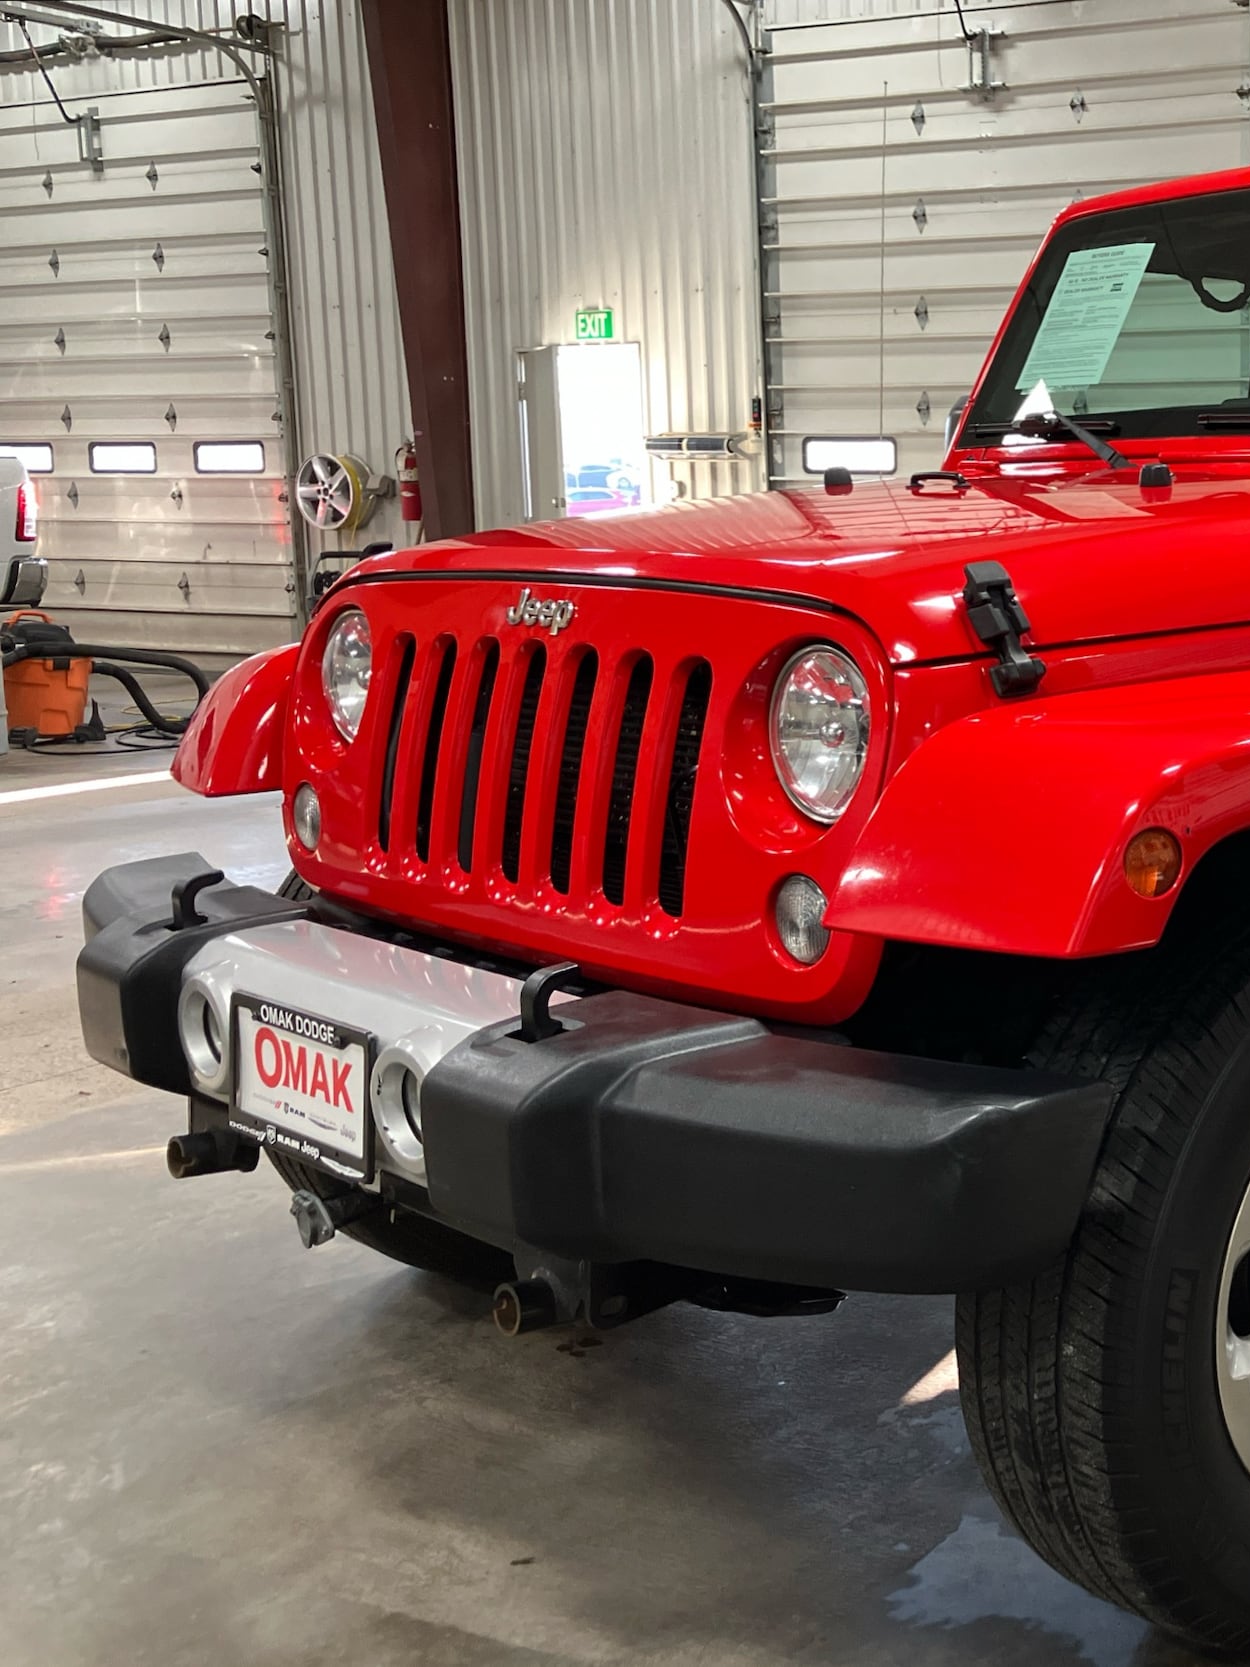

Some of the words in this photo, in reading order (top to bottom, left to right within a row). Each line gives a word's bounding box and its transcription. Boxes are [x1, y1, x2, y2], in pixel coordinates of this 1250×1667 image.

[577, 313, 608, 338] EXIT
[506, 588, 574, 636] Jeep
[260, 1004, 294, 1031] OMAK
[295, 1015, 335, 1044] DODGE
[254, 1026, 354, 1114] OMAK
[289, 1106, 306, 1119] RAM
[276, 1133, 301, 1150] RAM
[301, 1140, 320, 1161] Jeep
[1160, 1270, 1200, 1488] CHELIN
